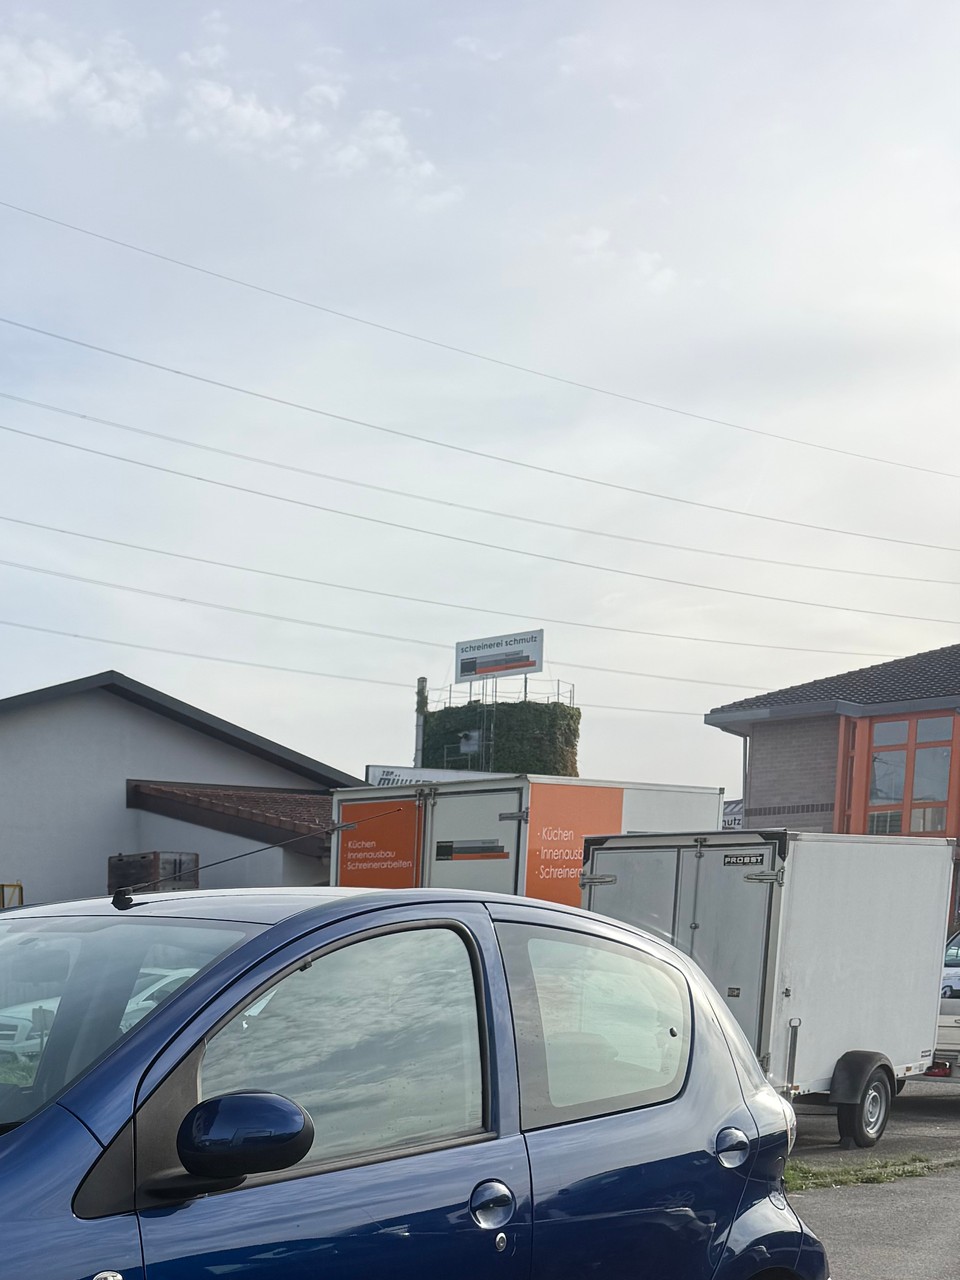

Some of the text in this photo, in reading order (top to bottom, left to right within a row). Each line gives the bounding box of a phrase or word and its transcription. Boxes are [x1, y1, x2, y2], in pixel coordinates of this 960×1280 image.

[461, 635, 538, 654] schreinerei schmutz
[542, 826, 574, 841] Küchen
[348, 840, 376, 848] Küchen
[347, 850, 396, 859] Innenausbau
[540, 846, 584, 860] Innenausb
[347, 859, 413, 870] Schreinerarbeiten
[725, 856, 763, 864] PROBST
